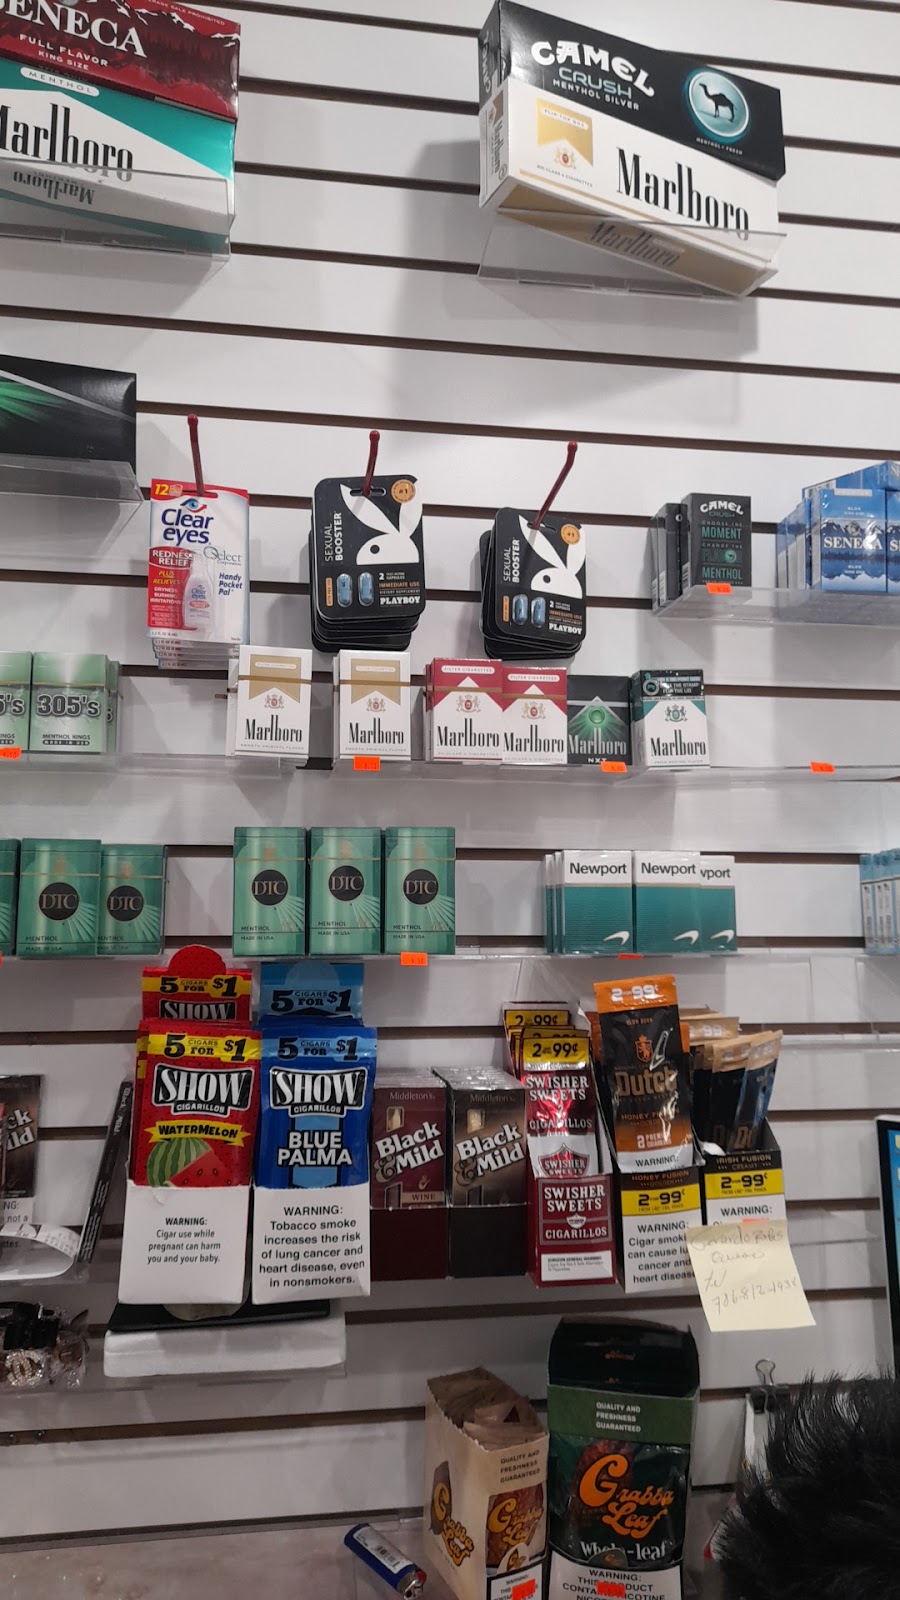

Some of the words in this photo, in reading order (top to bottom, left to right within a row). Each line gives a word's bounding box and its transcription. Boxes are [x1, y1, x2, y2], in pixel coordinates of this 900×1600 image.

[20, 34, 54, 51] FULL
[59, 46, 109, 67] FLAVOR
[38, 51, 63, 64] KING
[66, 59, 89, 71] SIZE
[530, 40, 655, 97] CAMEL
[28, 71, 93, 94] MENTHOL
[558, 67, 632, 100] CRUSH
[552, 79, 601, 100] MENTHOL
[605, 94, 640, 112] SILVER
[13, 170, 96, 205] Marlboro
[616, 146, 749, 241] Marlboro
[589, 221, 682, 267] Marlboro
[154, 483, 169, 496] 12
[700, 500, 744, 515] CAMEL
[161, 508, 214, 530] Clear
[163, 527, 210, 547] eyes
[334, 512, 343, 562] BOOSTER
[701, 526, 742, 540] MOMENT
[325, 523, 333, 562] SEXUAL
[823, 536, 883, 551] SENECA
[158, 557, 189, 567] RELIEF
[503, 546, 512, 582] SEXUAL
[512, 538, 520, 583] BOOSTER
[219, 572, 242, 582] Handy
[702, 566, 742, 580] MENTHOL
[219, 581, 243, 592] Pocket
[219, 588, 231, 597] Pal
[380, 596, 420, 605] PLAYBOY
[549, 600, 554, 608] 2
[549, 623, 582, 635] PLAYBOY
[36, 694, 101, 718] 305's
[245, 714, 303, 743] Marlboro
[349, 718, 404, 745] Marlboro
[437, 718, 500, 748] Marlboro
[503, 725, 564, 753] Marlboro
[568, 727, 627, 755] Marlboro
[650, 729, 707, 757] Marlboro
[570, 862, 627, 876] Newport
[641, 862, 696, 876] Newport
[254, 880, 287, 896] DTC
[331, 875, 363, 891] DTC
[405, 880, 437, 895] DTC
[41, 893, 77, 909] DTC
[109, 896, 142, 911] DTC
[160, 977, 179, 993] 5
[212, 976, 238, 997] $1
[271, 990, 294, 1012] 5
[327, 989, 352, 1011] $1
[611, 988, 623, 1002] 2
[164, 1034, 187, 1058] 5
[187, 1038, 219, 1046] CIGARS
[223, 1038, 247, 1061] $1
[277, 1037, 299, 1059] 5
[303, 1047, 327, 1056] FOR
[335, 1038, 358, 1060] $1
[532, 1043, 542, 1057] 2
[552, 1042, 579, 1057] 99¢
[190, 1047, 214, 1055] FOR
[159, 1069, 246, 1105] SHOW
[275, 1071, 360, 1105] SHOW
[525, 1075, 590, 1090] SWISHER
[614, 1066, 678, 1097] Dutch
[529, 1089, 586, 1102] SWEETS
[176, 1104, 225, 1113] CIGARILLOS
[294, 1105, 341, 1114] CIGARILLOS
[621, 1113, 649, 1121] HONEY
[158, 1124, 238, 1138] WATERMELON
[289, 1131, 342, 1149] BLUE
[375, 1121, 441, 1159] Black
[456, 1123, 521, 1161] Black
[278, 1149, 352, 1166] PALMA
[373, 1156, 397, 1184] &
[394, 1139, 445, 1175] Mild
[476, 1142, 525, 1176] Mild
[544, 1158, 585, 1169] SWISHER
[635, 1155, 678, 1167] WARNING:
[716, 1155, 739, 1164] IRISH
[741, 1154, 771, 1162] FUSION
[632, 1172, 660, 1181] HONEY
[662, 1170, 689, 1179] FUSION
[721, 1176, 732, 1189] 2
[741, 1172, 768, 1188] 99¢
[411, 1193, 437, 1201] WINE
[544, 1184, 606, 1199] SWISHER
[638, 1194, 650, 1206] 2
[660, 1190, 685, 1205] 99¢
[283, 1205, 343, 1216] WARNING:
[547, 1198, 602, 1212] SWEETS
[720, 1204, 772, 1216] WARNING:
[165, 1217, 208, 1226] WARNING:
[270, 1220, 317, 1231] Tobacco
[320, 1219, 357, 1229] smoke
[637, 1220, 689, 1233] WARNING:
[156, 1229, 177, 1240] Cigar
[193, 1229, 215, 1238] while
[264, 1234, 318, 1245] increases
[321, 1233, 339, 1244] the
[341, 1231, 361, 1243] risk
[545, 1226, 607, 1240] CIGARILLOS
[148, 1242, 185, 1252] pregnant
[200, 1242, 221, 1250] harm
[628, 1235, 656, 1248] Cigar
[147, 1256, 161, 1265] you
[163, 1255, 178, 1263] and
[180, 1256, 198, 1264] your
[199, 1255, 221, 1264] baby.
[261, 1249, 273, 1260] of
[275, 1248, 300, 1261] lung
[303, 1248, 341, 1258] cancer
[344, 1245, 363, 1256] and
[628, 1250, 645, 1259] can
[648, 1248, 675, 1258] cause
[259, 1262, 288, 1274] heart
[291, 1261, 337, 1273] disease,
[339, 1260, 365, 1271] even
[638, 1261, 670, 1271] cancer
[673, 1258, 691, 1268] and
[269, 1278, 280, 1288] in
[283, 1275, 356, 1287] nonsmokers.
[633, 1272, 659, 1284] heart
[596, 1402, 625, 1412] QUALITY
[626, 1404, 641, 1413] AND
[596, 1412, 637, 1422] FRESHNESS
[595, 1422, 641, 1433] GUARANTEED
[500, 1453, 526, 1464] QUALITY
[527, 1450, 540, 1458] AND
[500, 1460, 537, 1473] FRESHNESS
[500, 1469, 540, 1483] GUARANTEED
[579, 1454, 674, 1507] Grabba
[601, 1501, 669, 1540] Leaf
[589, 1569, 642, 1582] WARNING:
